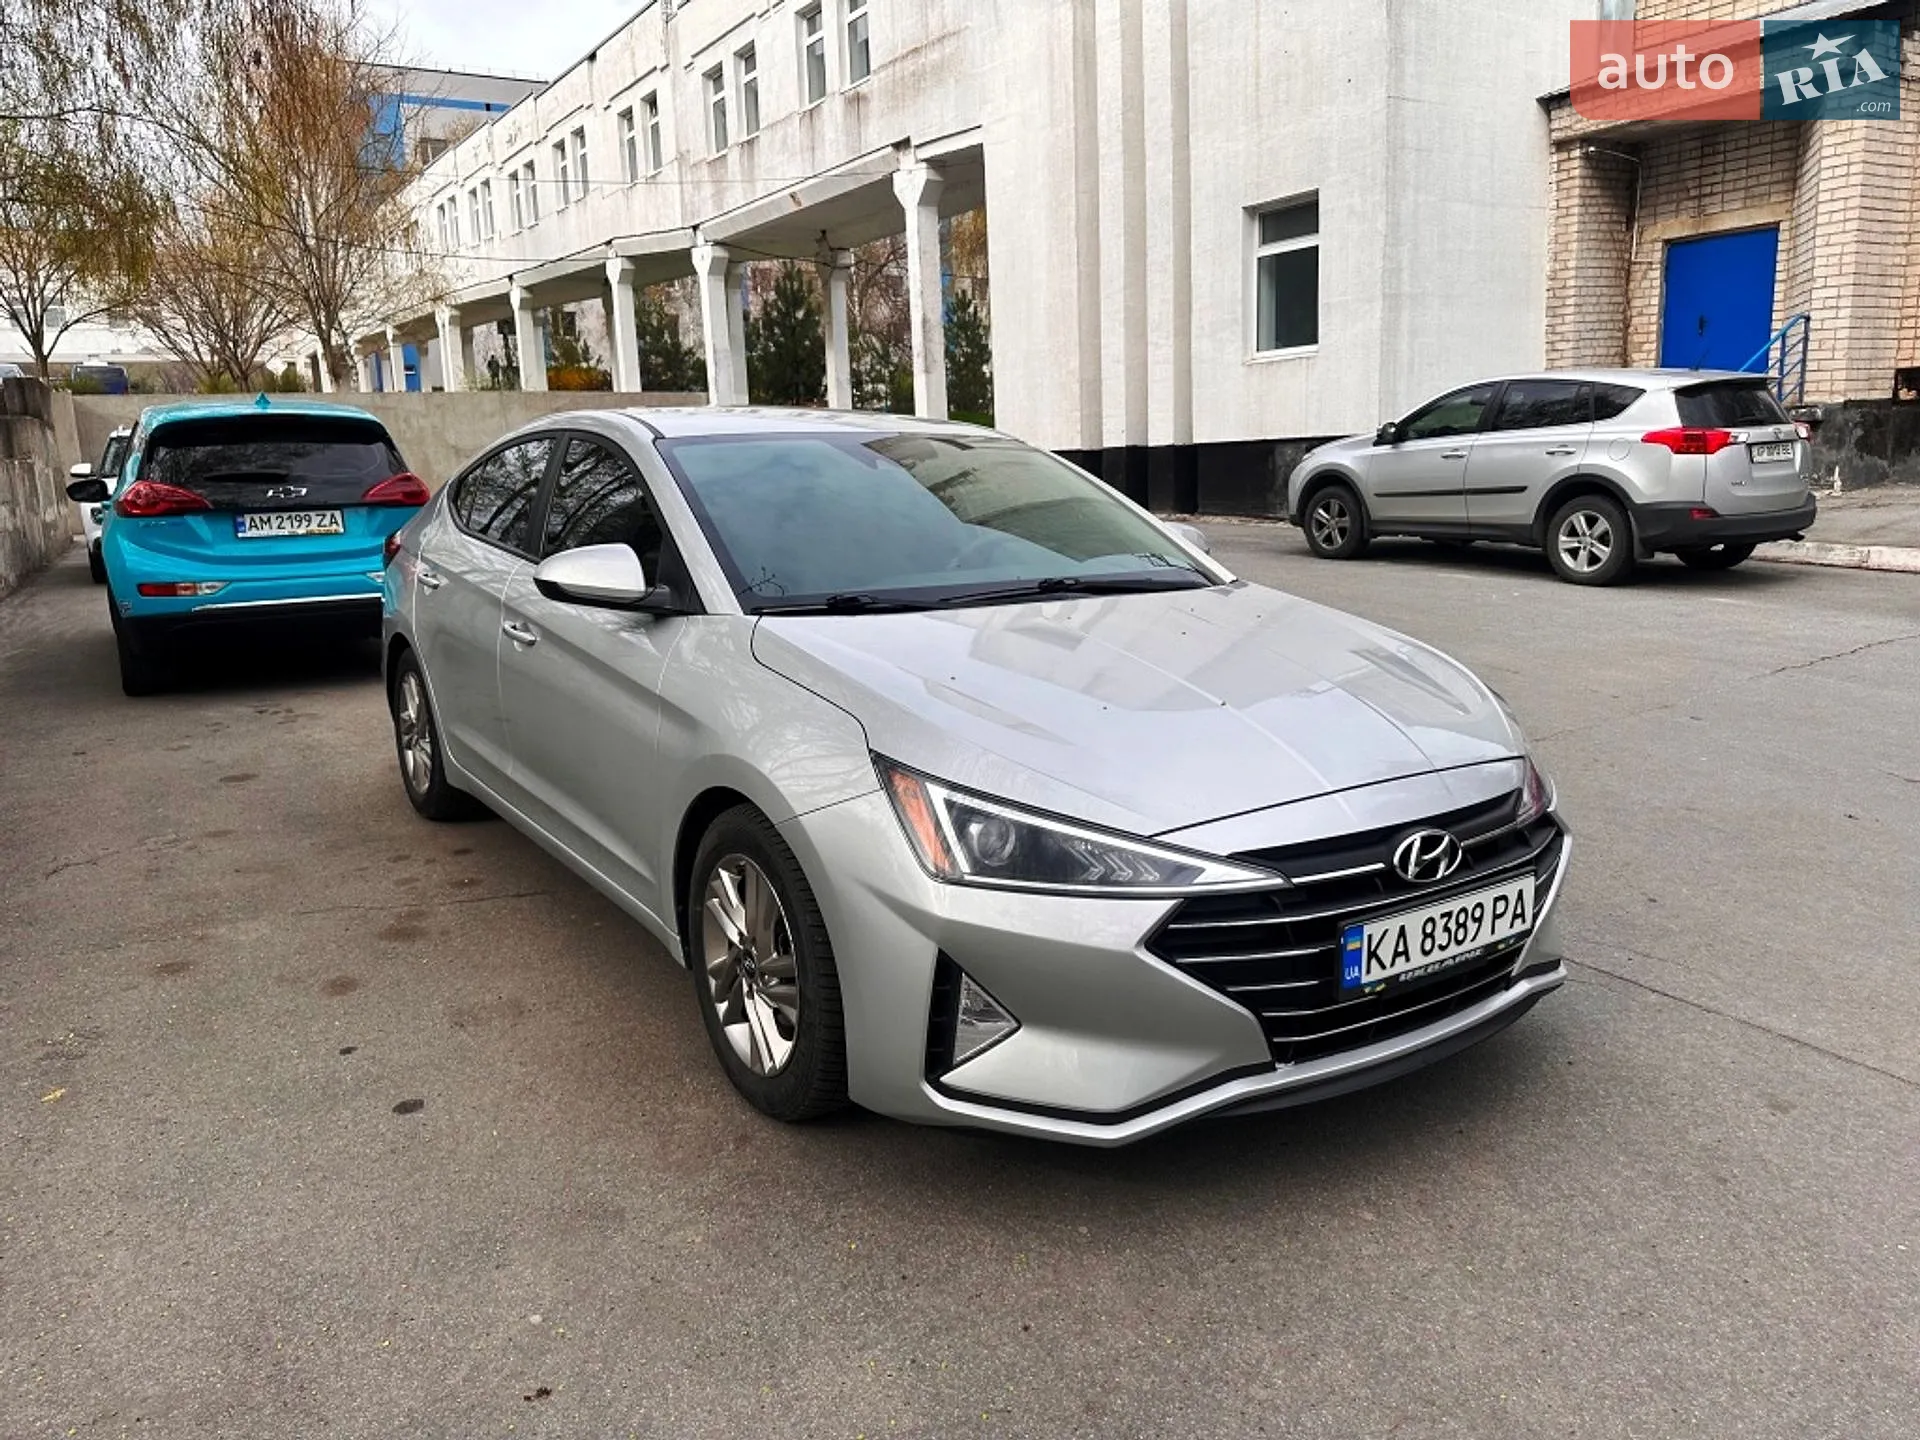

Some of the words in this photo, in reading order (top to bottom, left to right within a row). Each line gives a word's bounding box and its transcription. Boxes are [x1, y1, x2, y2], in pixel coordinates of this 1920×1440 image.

[248, 515, 272, 531] AM
[275, 513, 312, 529] 2199
[315, 511, 339, 528] ZA
[1365, 924, 1410, 976] KA
[1420, 901, 1485, 958] 8389
[1490, 888, 1526, 936] PA
[1344, 965, 1360, 980] UA
